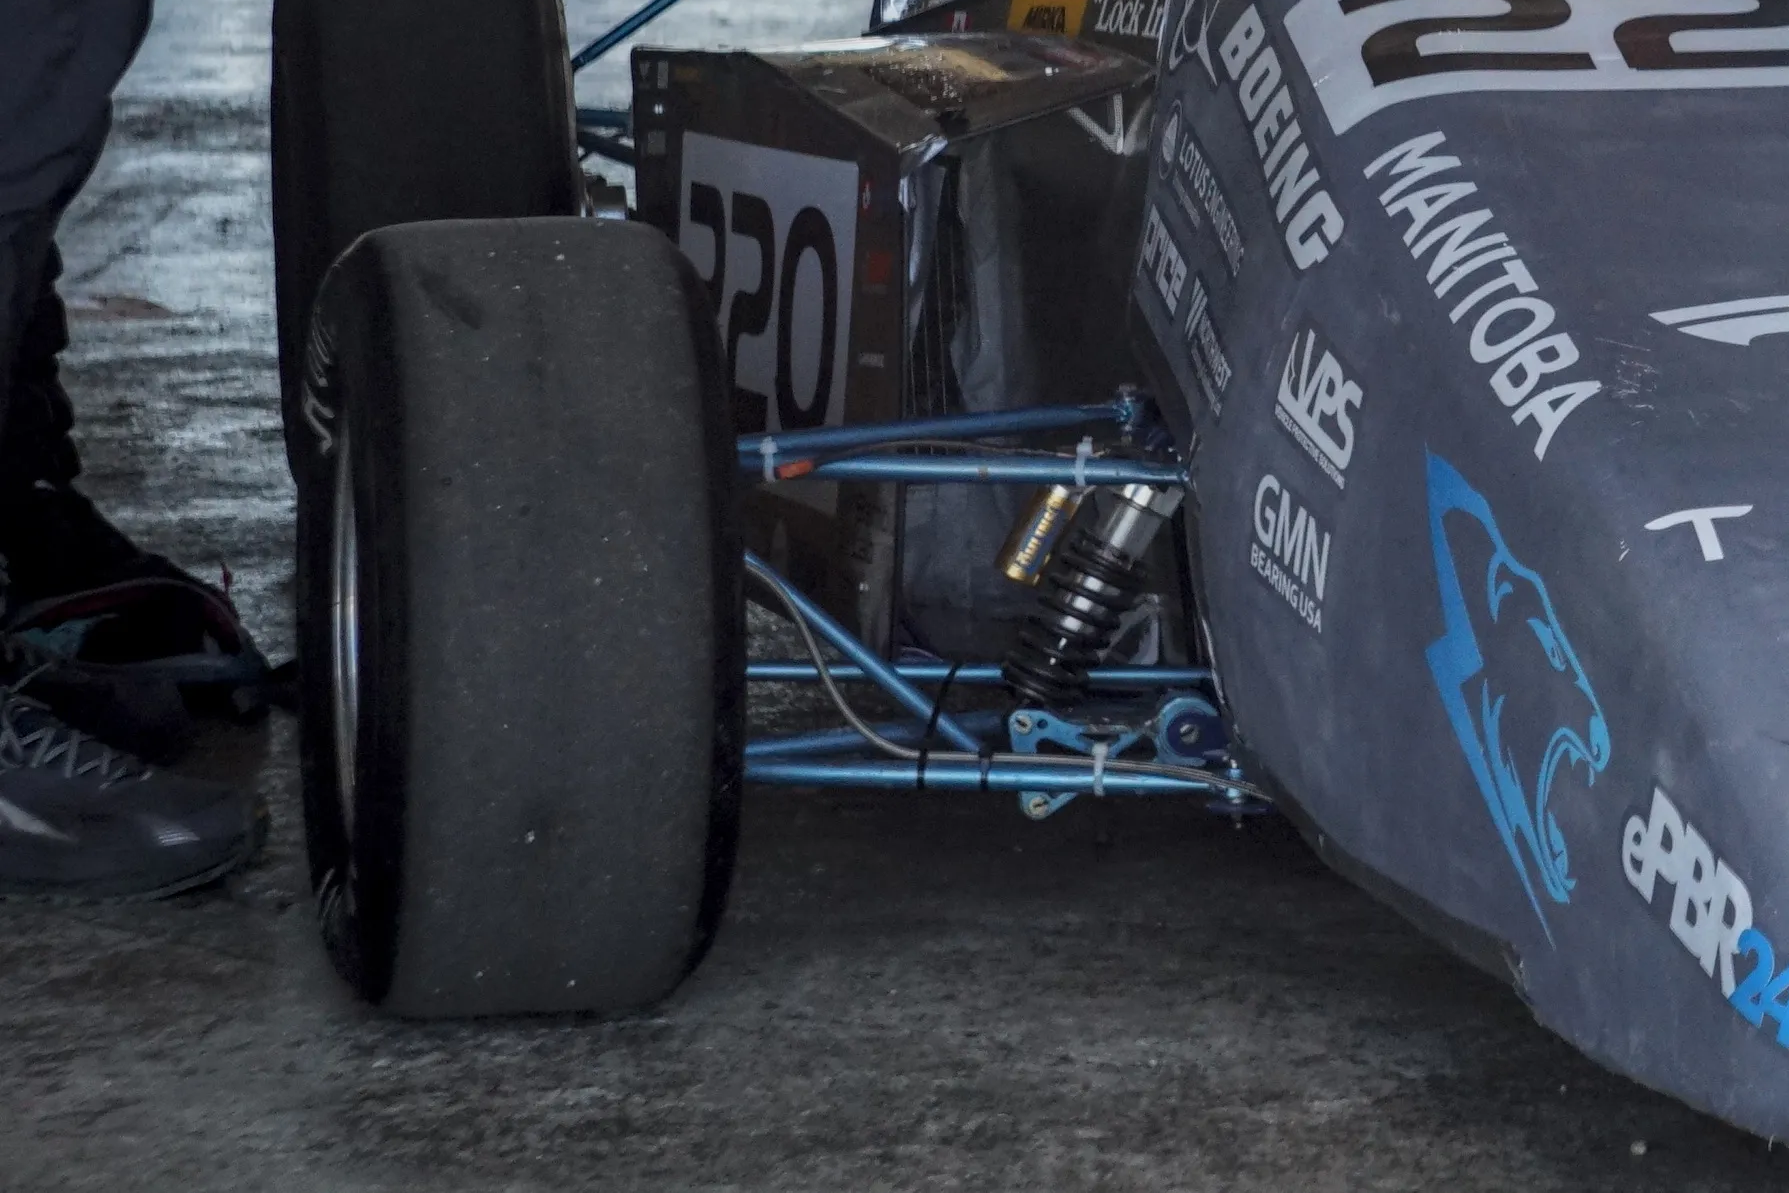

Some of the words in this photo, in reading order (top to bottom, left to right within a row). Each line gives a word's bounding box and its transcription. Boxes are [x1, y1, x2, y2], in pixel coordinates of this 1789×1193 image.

[1178, 133, 1207, 199] LOTUS
[1219, 4, 1345, 270] BOEING
[690, 181, 838, 430] 220
[1363, 130, 1601, 461] MANITOBA
[1250, 542, 1299, 609] BEARING
[1298, 599, 1322, 633] USA
[1253, 474, 1331, 601] GMN
